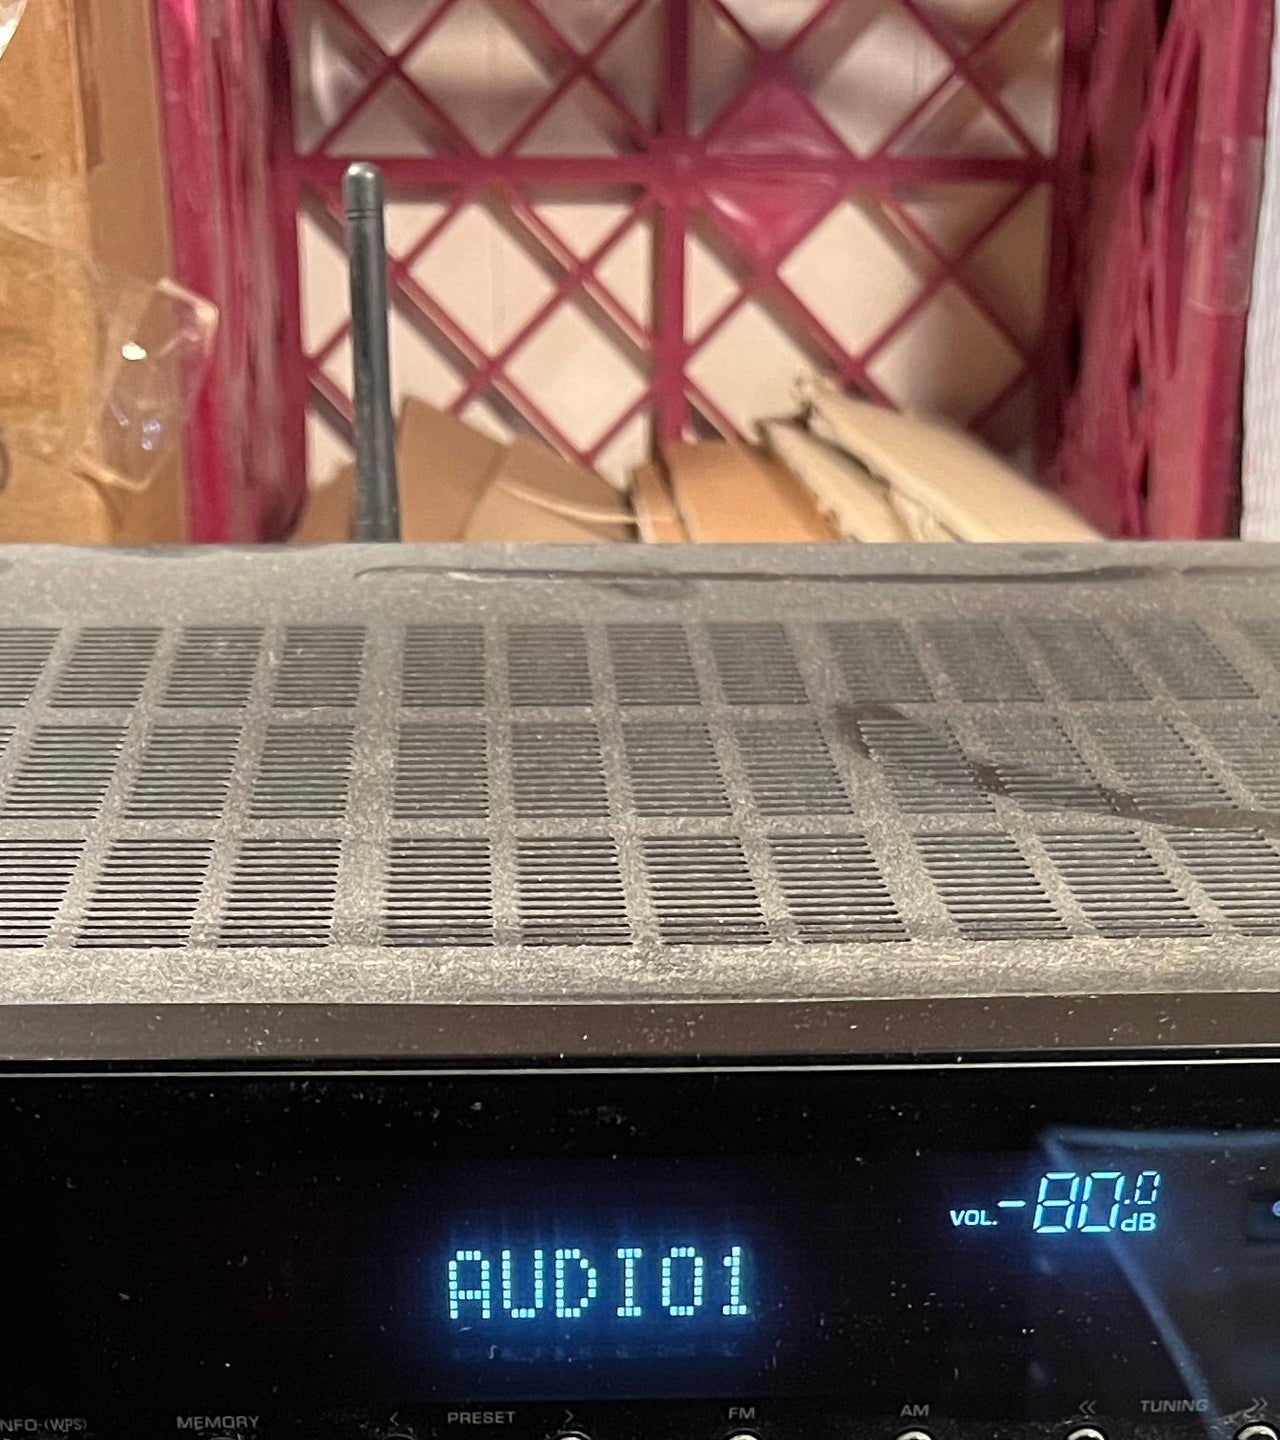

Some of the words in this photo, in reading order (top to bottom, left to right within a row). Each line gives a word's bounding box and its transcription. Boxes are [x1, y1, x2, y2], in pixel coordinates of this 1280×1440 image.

[1120, 1211, 1157, 1233] dB
[448, 1246, 747, 1320] AUDIO1
[728, 1406, 756, 1419] FM
[900, 1403, 930, 1418] AM
[1140, 1399, 1209, 1414] TUNING
[176, 1415, 260, 1431] MEMORY
[447, 1410, 516, 1425] PRESET
